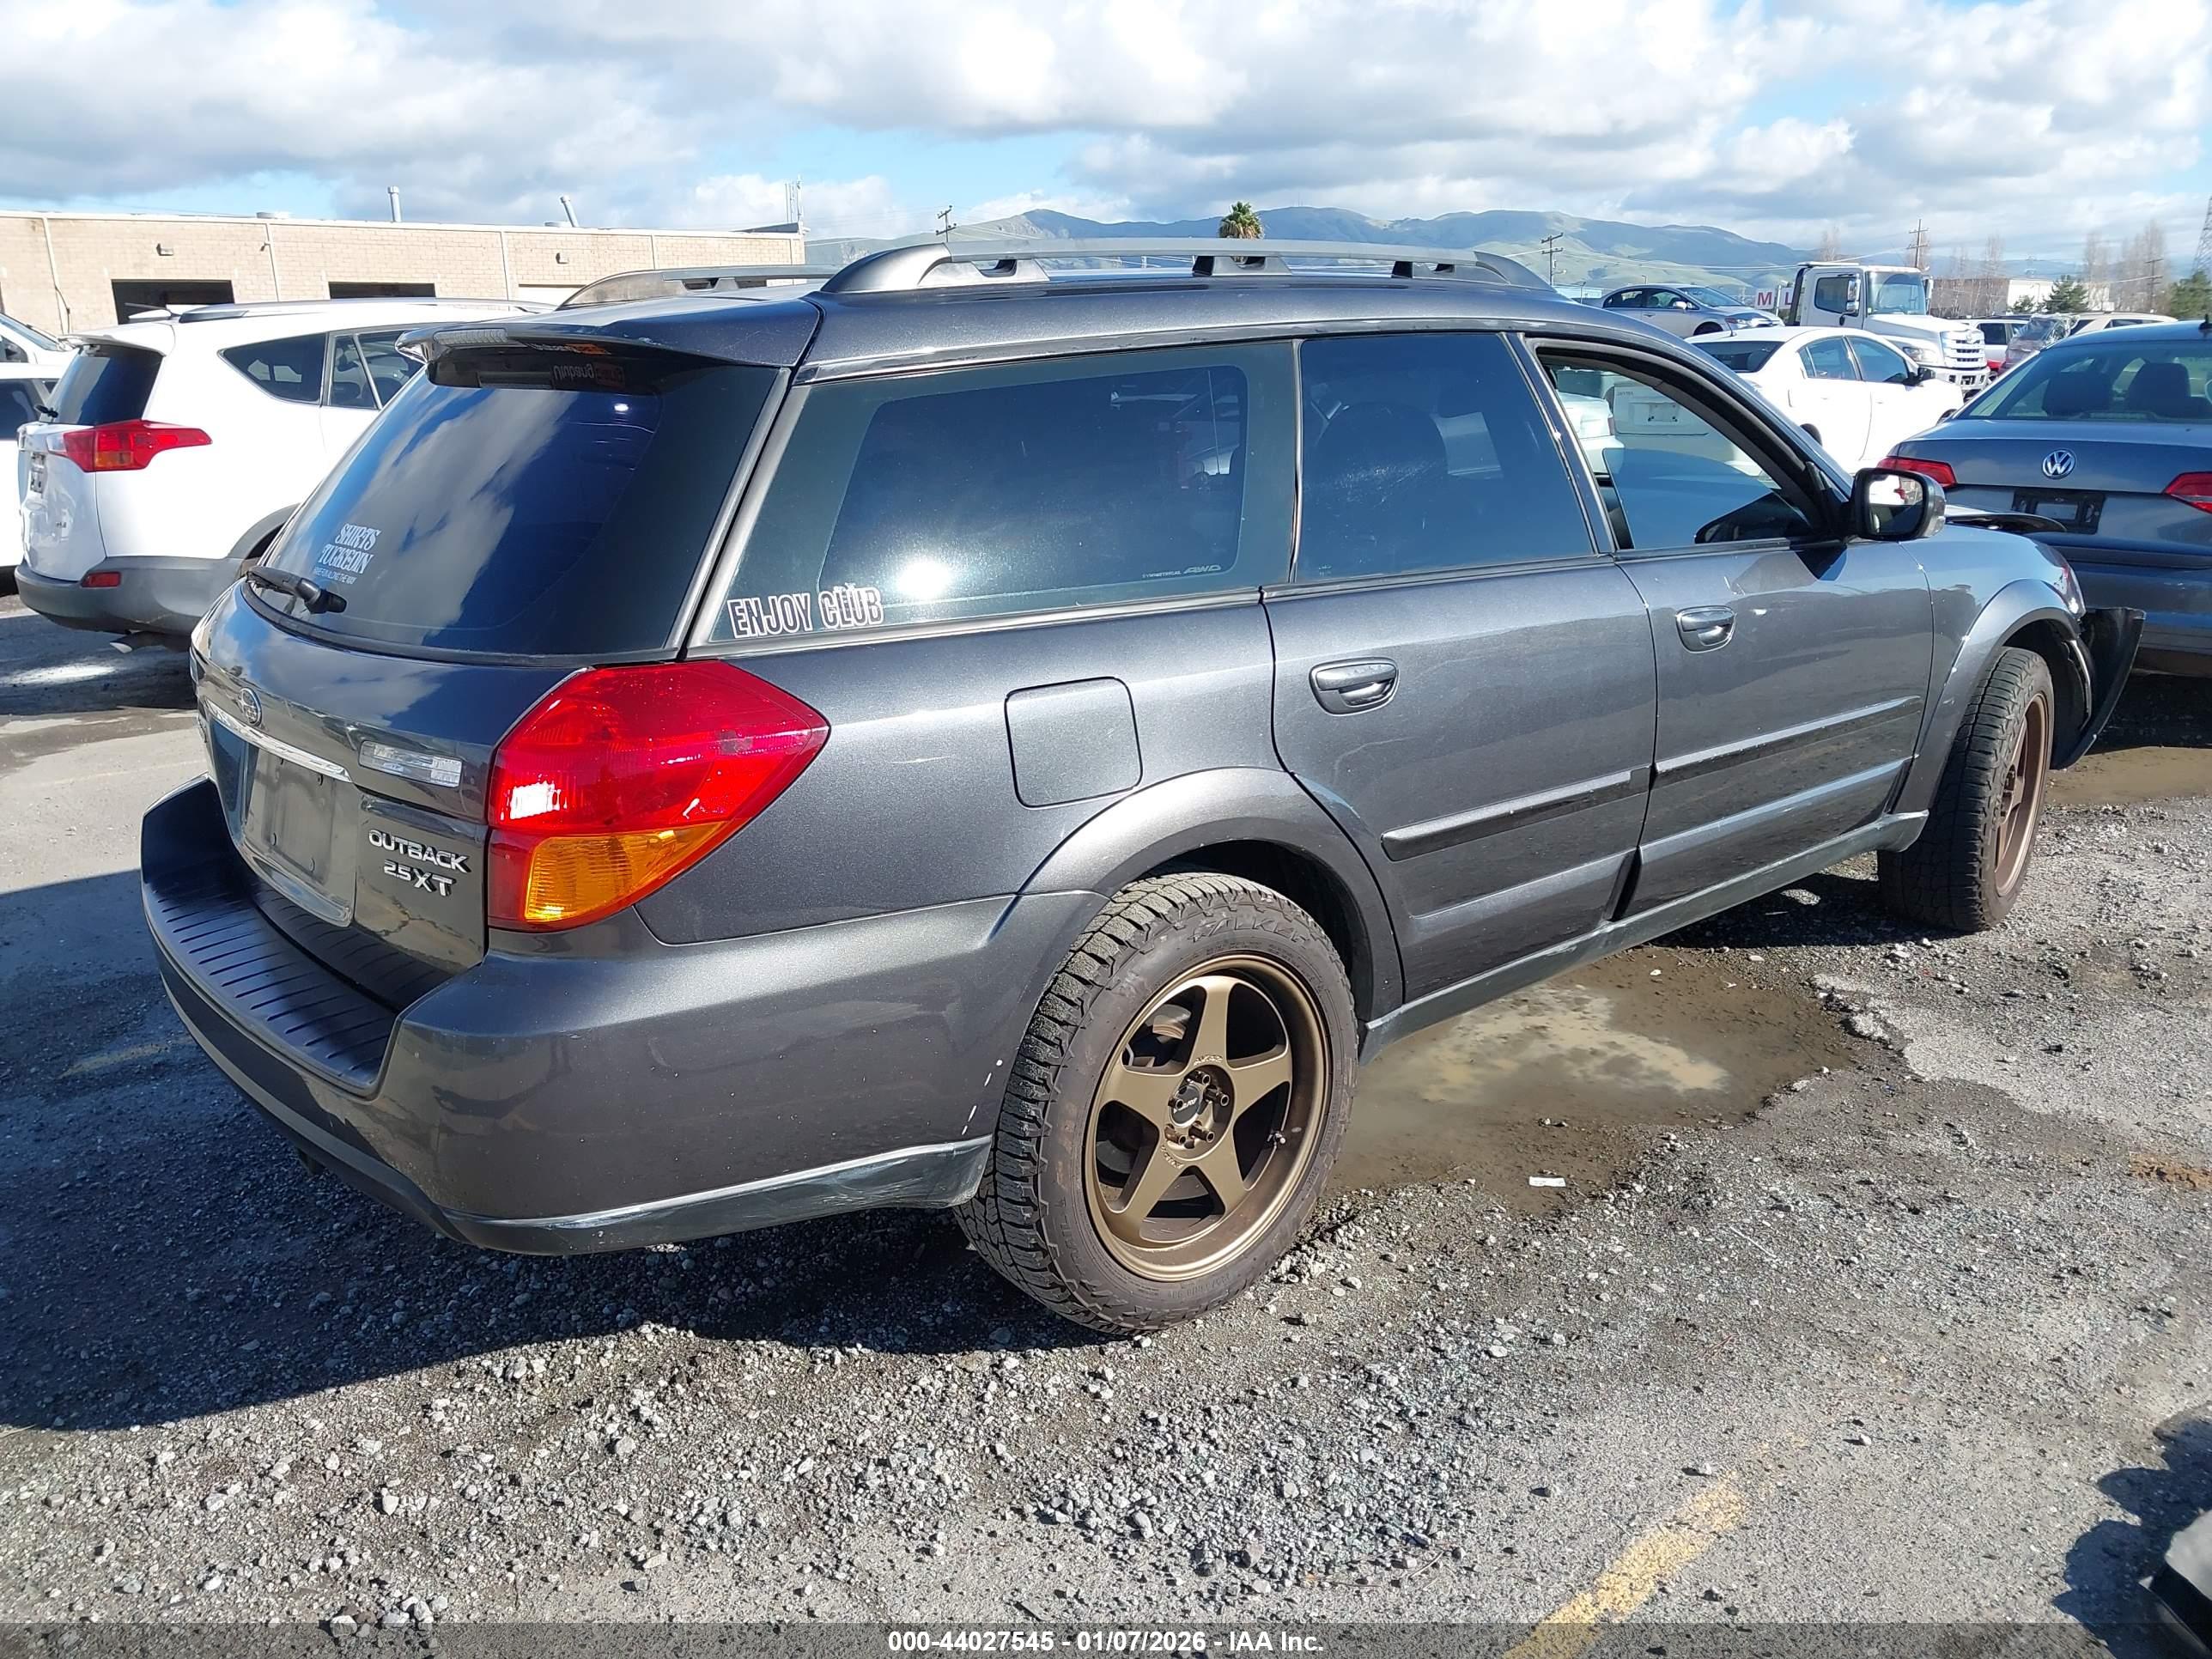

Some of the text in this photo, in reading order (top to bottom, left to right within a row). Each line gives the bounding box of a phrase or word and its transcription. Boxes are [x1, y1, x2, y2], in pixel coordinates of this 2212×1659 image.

[1758, 291, 1772, 306] M
[335, 523, 382, 550] SHIRTS
[1183, 564, 1221, 574] AWD
[727, 586, 884, 638] ENJOY CLUB
[368, 830, 469, 872] OUTBACK
